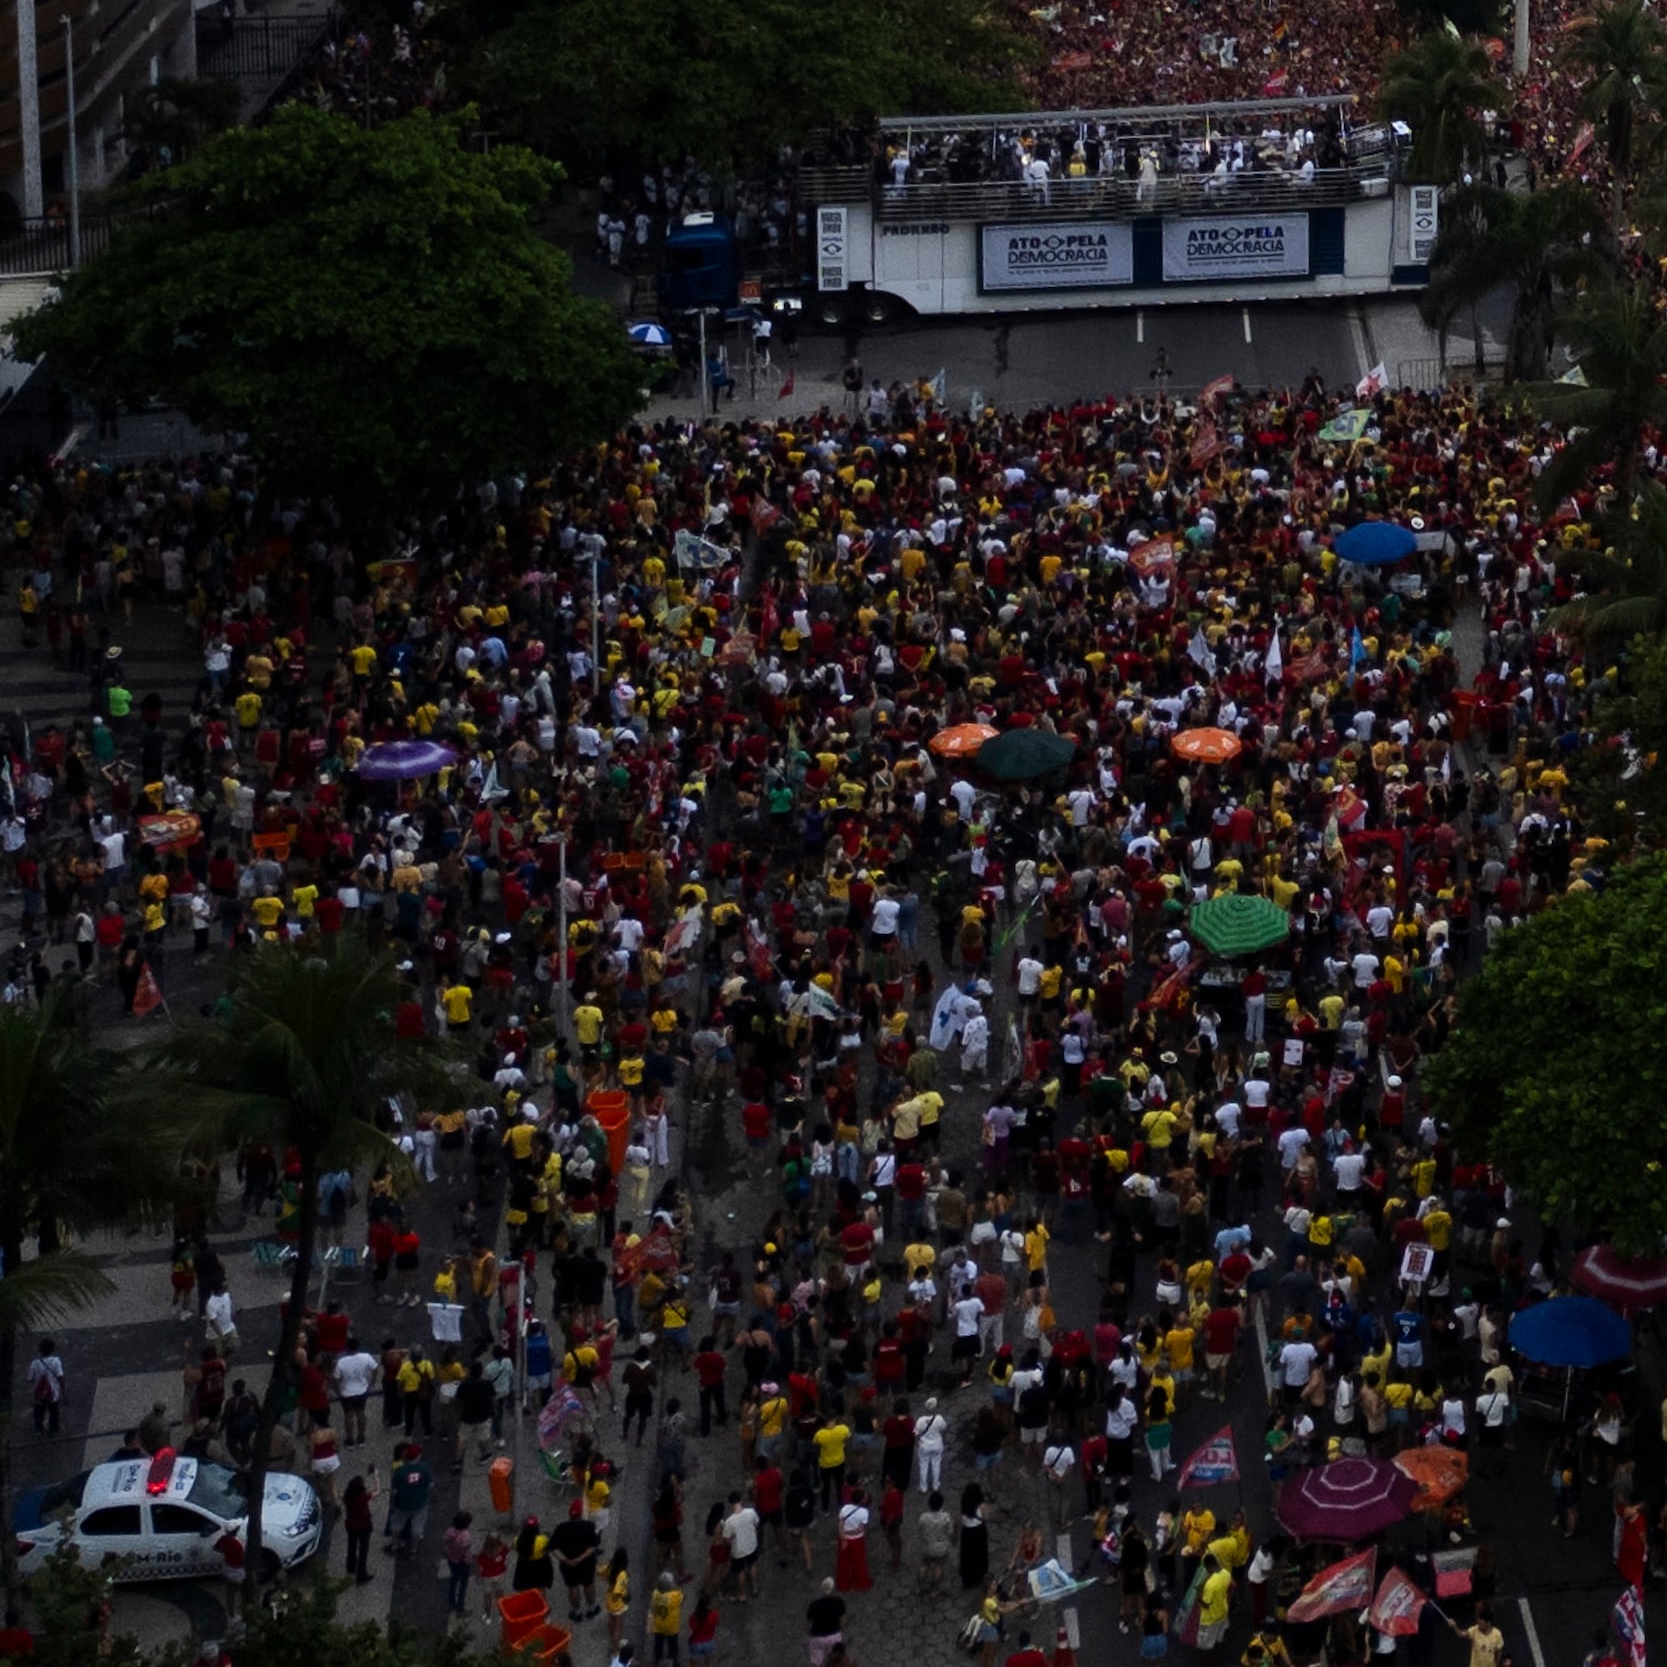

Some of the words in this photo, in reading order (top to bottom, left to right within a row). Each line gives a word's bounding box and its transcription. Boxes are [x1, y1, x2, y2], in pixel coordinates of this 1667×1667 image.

[1008, 237, 1041, 250] ATO
[1066, 234, 1108, 247] PELA
[1187, 229, 1219, 242] ATO
[1244, 226, 1285, 239] PELA
[1186, 239, 1285, 256] DEMOCRACIA
[1007, 248, 1108, 264] DEMOCRACIA
